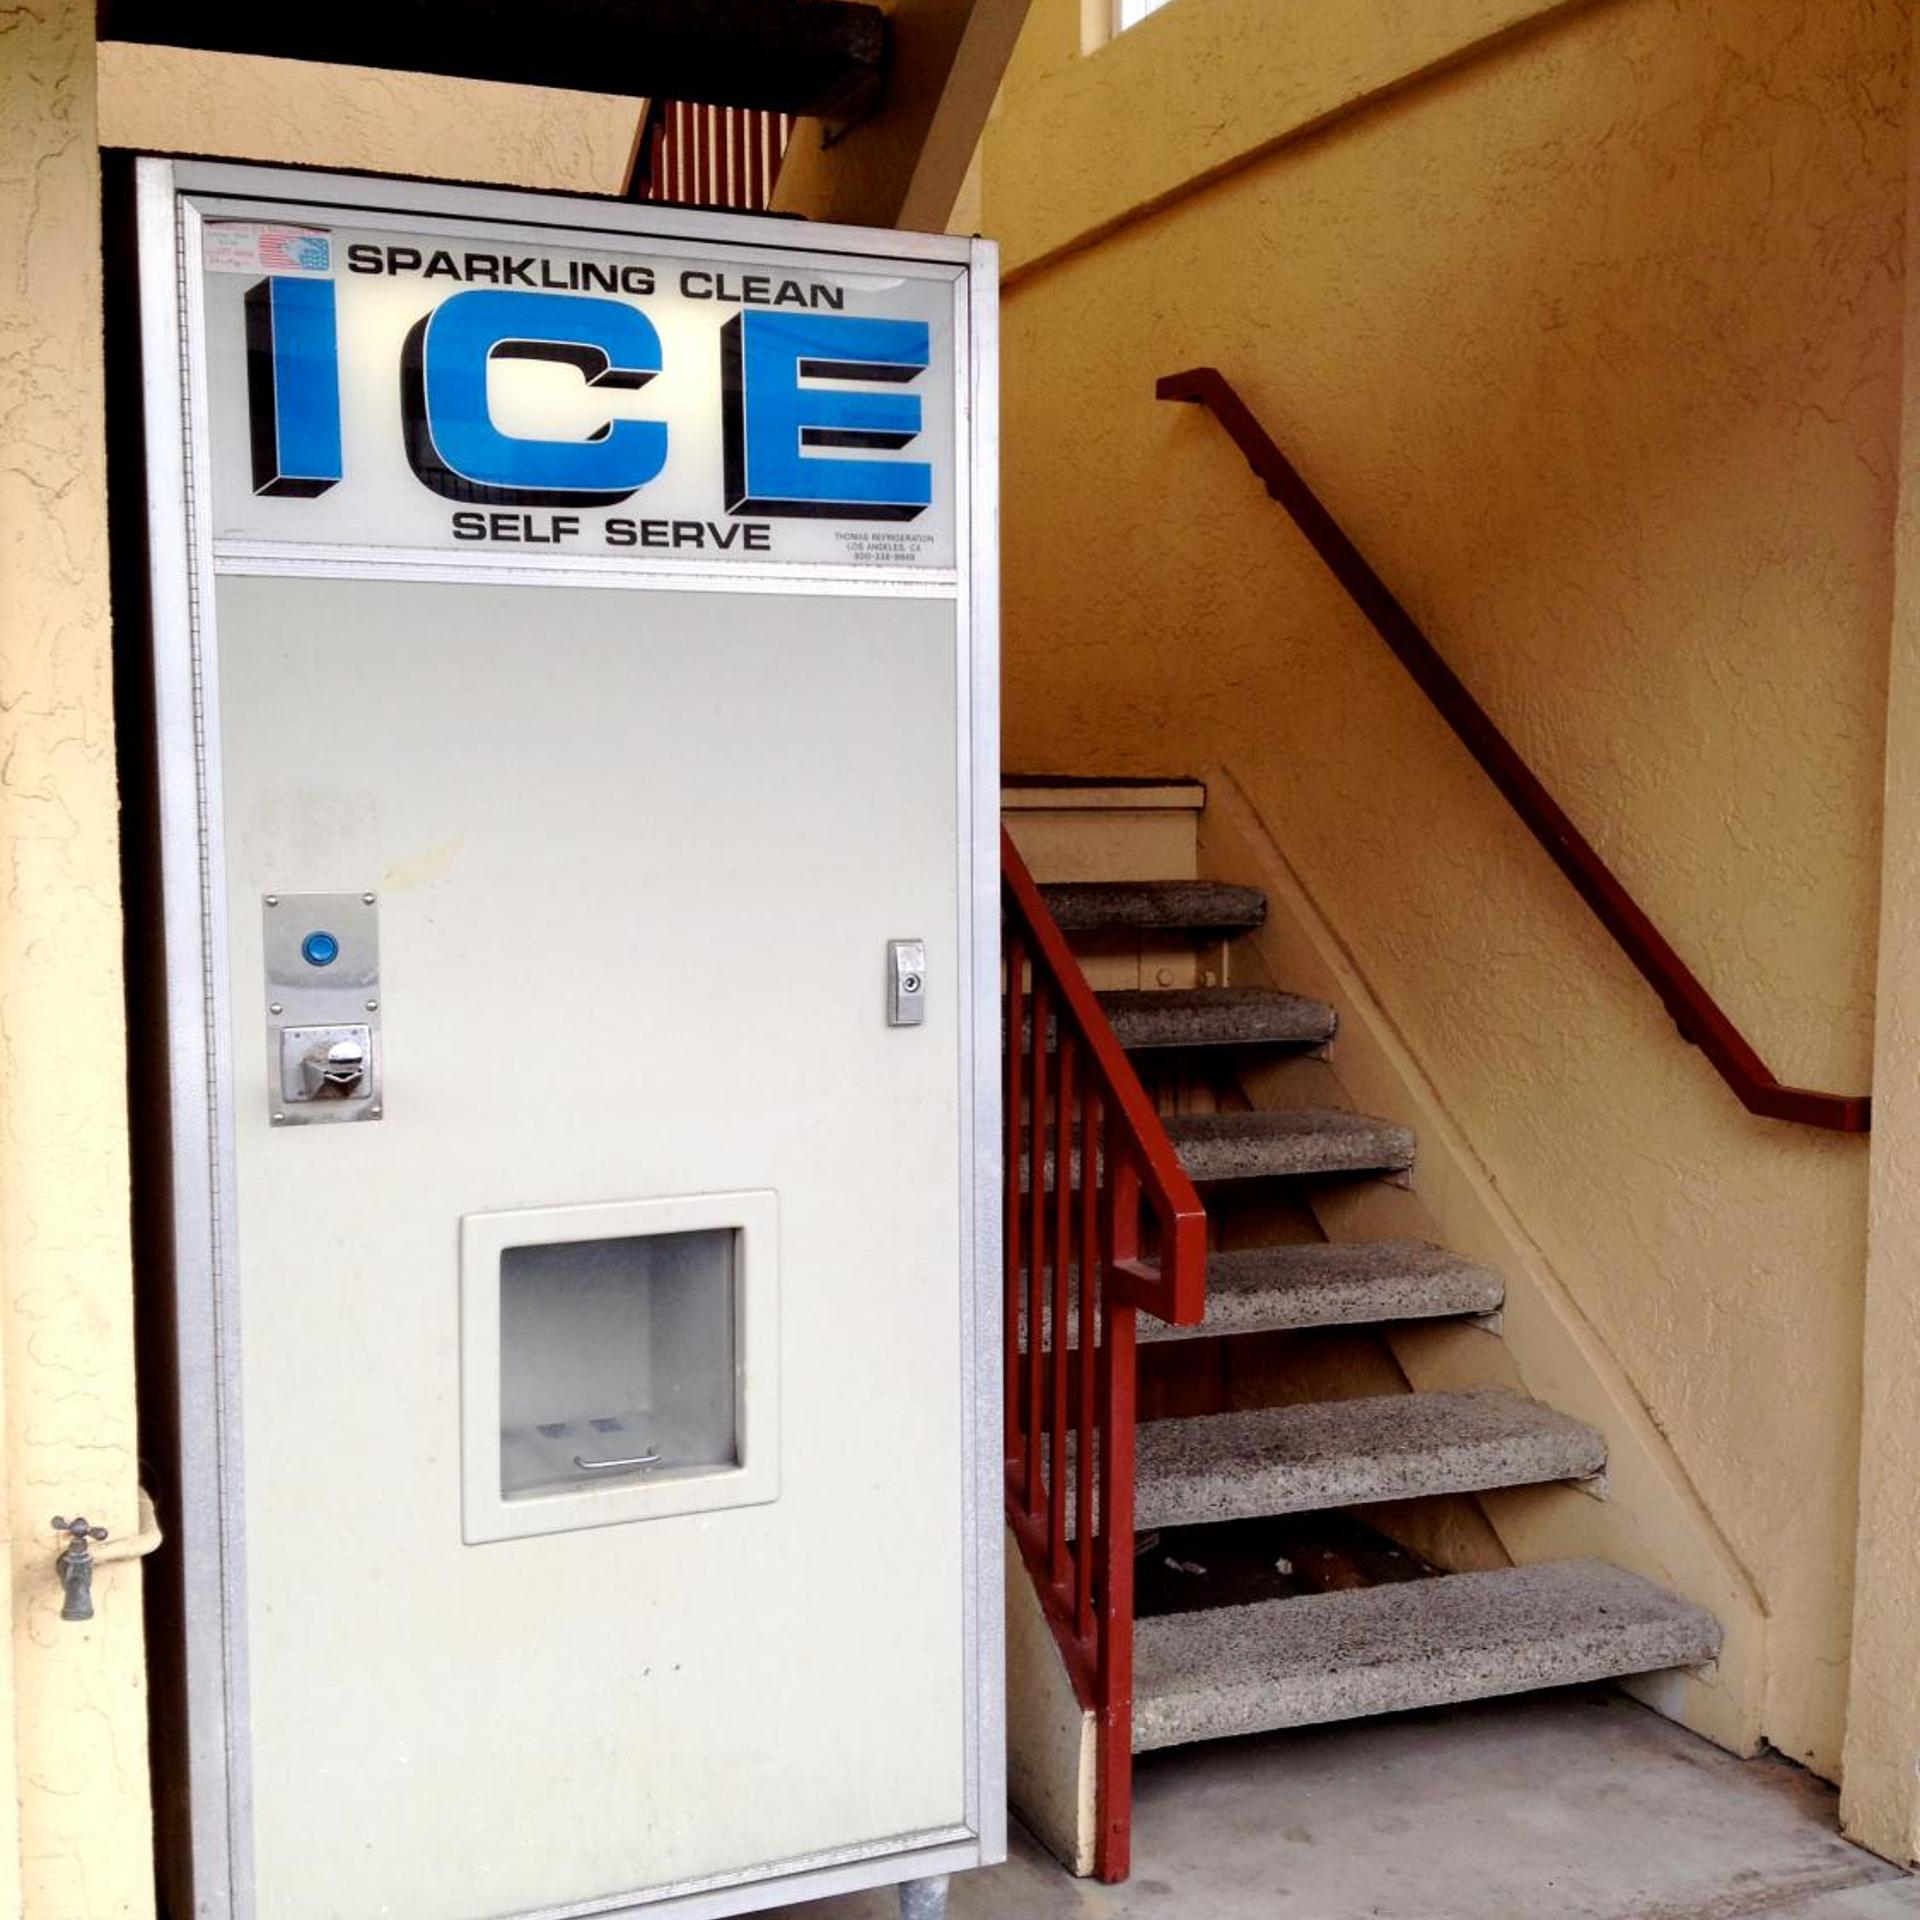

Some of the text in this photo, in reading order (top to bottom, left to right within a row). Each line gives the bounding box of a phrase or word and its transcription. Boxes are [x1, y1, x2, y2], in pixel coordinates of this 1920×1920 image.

[349, 244, 844, 310] SPARKLING CLEAN
[245, 275, 932, 522] ICE
[453, 513, 771, 551] SELF SERVE
[834, 532, 935, 543] THOMAS REFRIGERATION
[847, 542, 864, 551] LOS
[909, 544, 921, 552] CA
